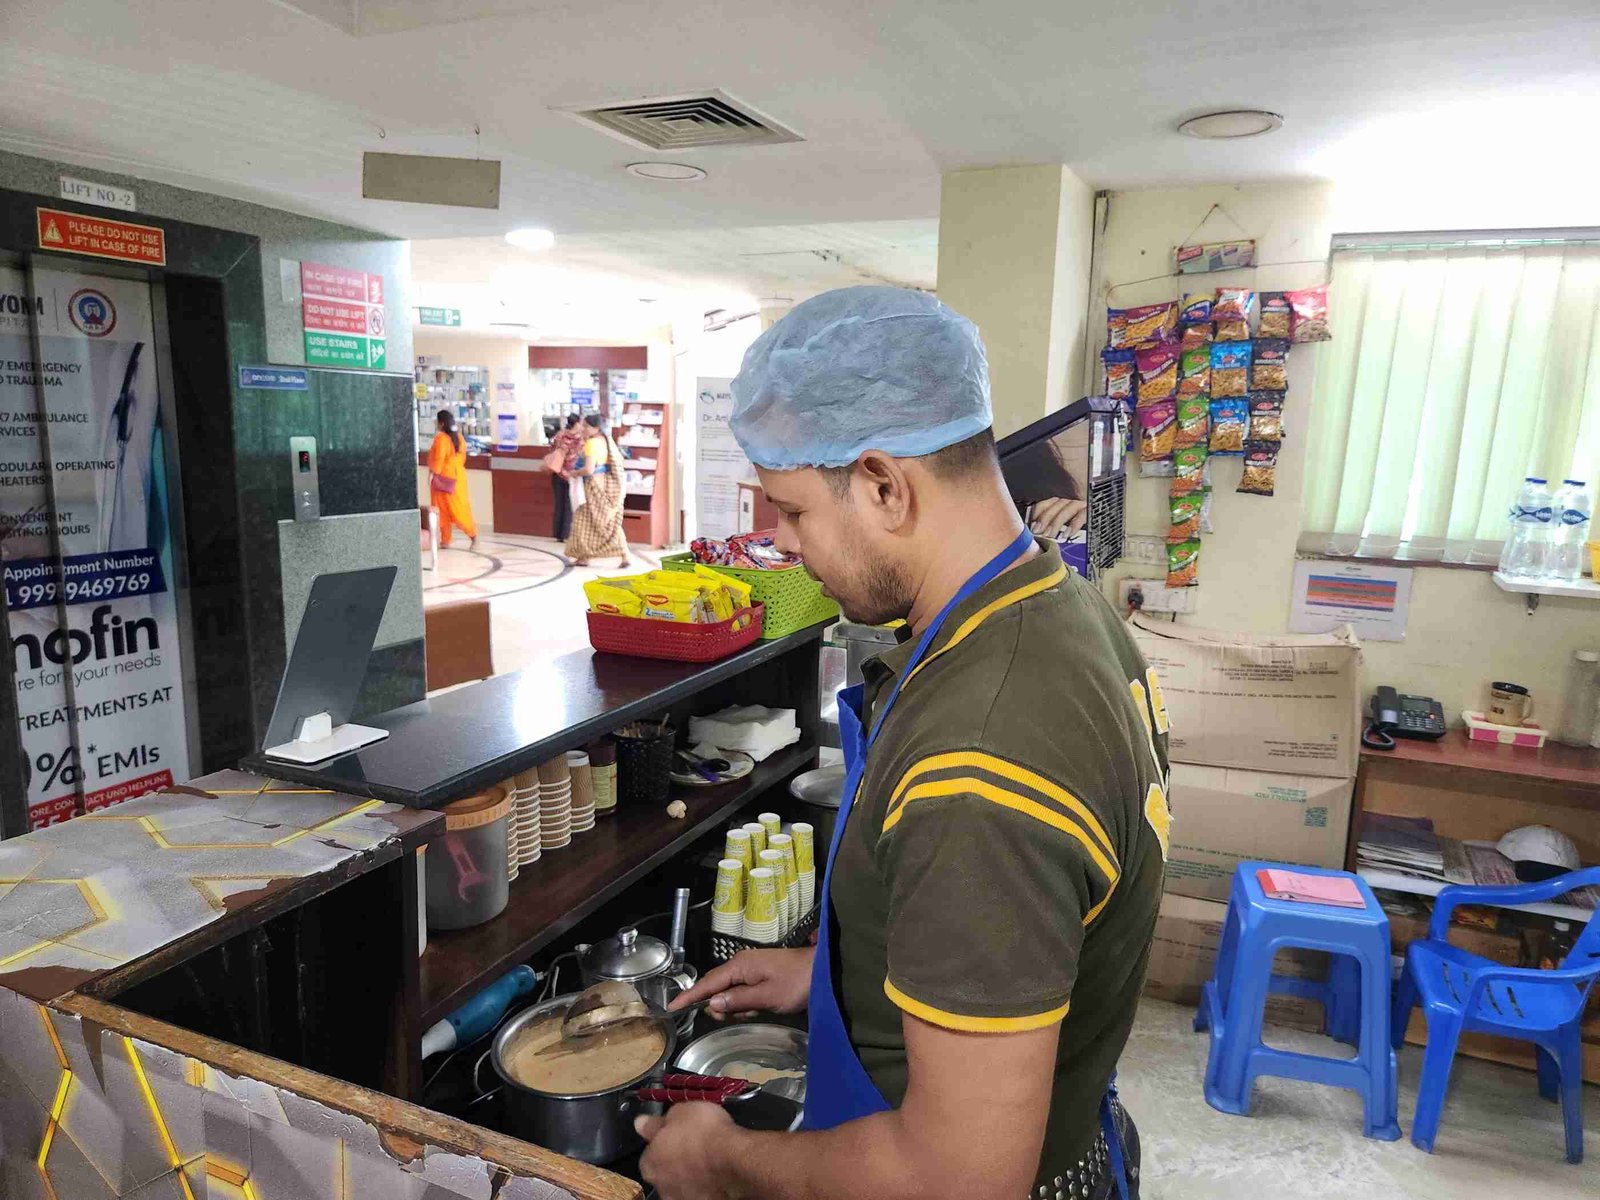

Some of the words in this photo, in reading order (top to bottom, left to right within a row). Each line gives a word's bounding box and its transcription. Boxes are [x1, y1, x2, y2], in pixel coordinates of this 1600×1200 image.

[62, 181, 91, 197] LIFT
[97, 189, 116, 202] NO
[69, 221, 104, 236] PLEASE
[106, 228, 121, 239] DO
[122, 230, 140, 241] NOT
[142, 234, 159, 245] USE
[69, 235, 88, 246] LIFT
[90, 238, 100, 248] IN
[102, 240, 126, 253] CASE
[127, 244, 139, 254] OF
[142, 247, 160, 258] FIRE
[309, 336, 327, 346] USE
[328, 338, 358, 350] STAIRS
[56, 460, 115, 471] OPERATING
[104, 555, 155, 571] Number
[39, 669, 62, 687] for
[74, 664, 110, 687] your
[114, 652, 161, 674] needs
[151, 686, 174, 705] AT
[97, 744, 161, 779] EMIs
[106, 786, 128, 801] UNO
[128, 773, 168, 793] HELPLINE
